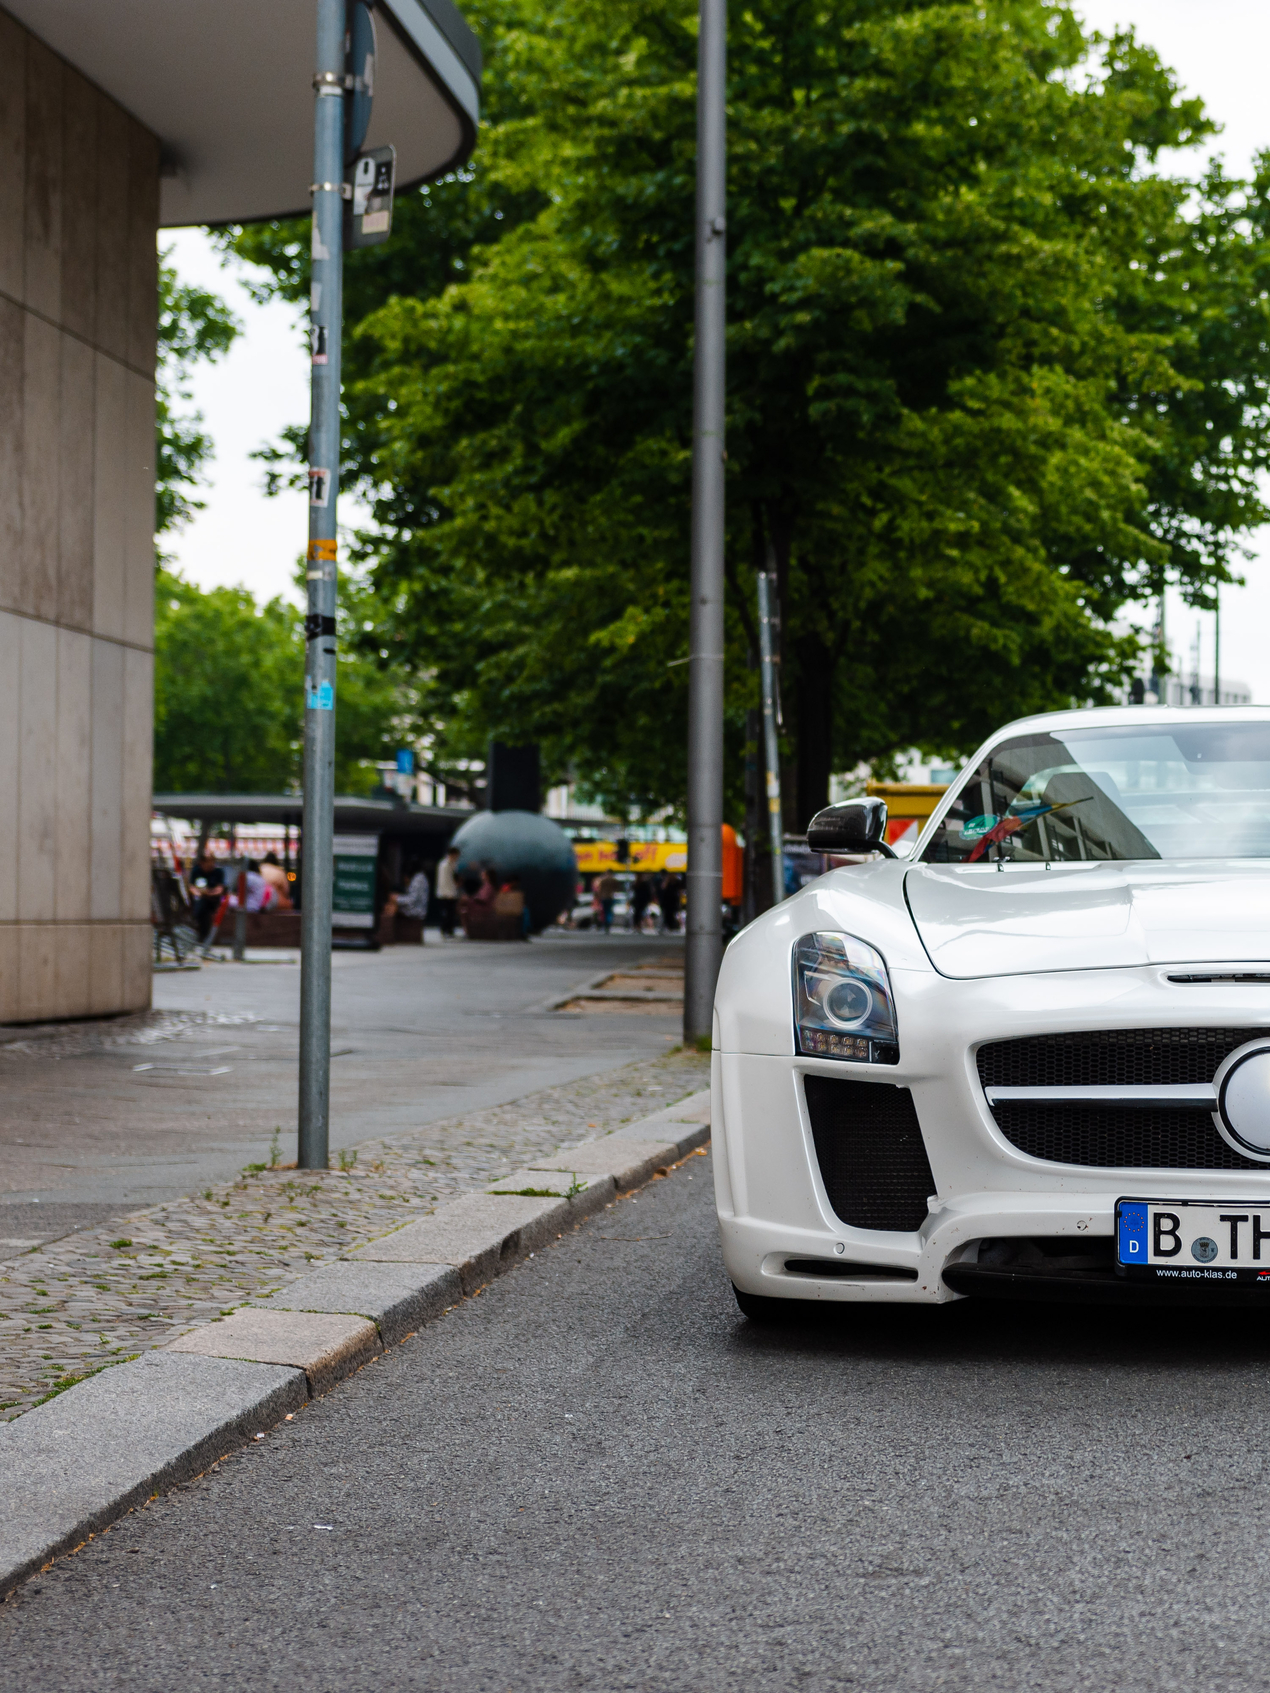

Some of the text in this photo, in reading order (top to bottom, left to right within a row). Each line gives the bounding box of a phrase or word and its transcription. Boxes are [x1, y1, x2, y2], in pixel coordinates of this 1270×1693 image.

[1153, 1212, 1183, 1258] B
[1129, 1240, 1140, 1253] D
[1156, 1268, 1238, 1280] www.auto-klas.de
